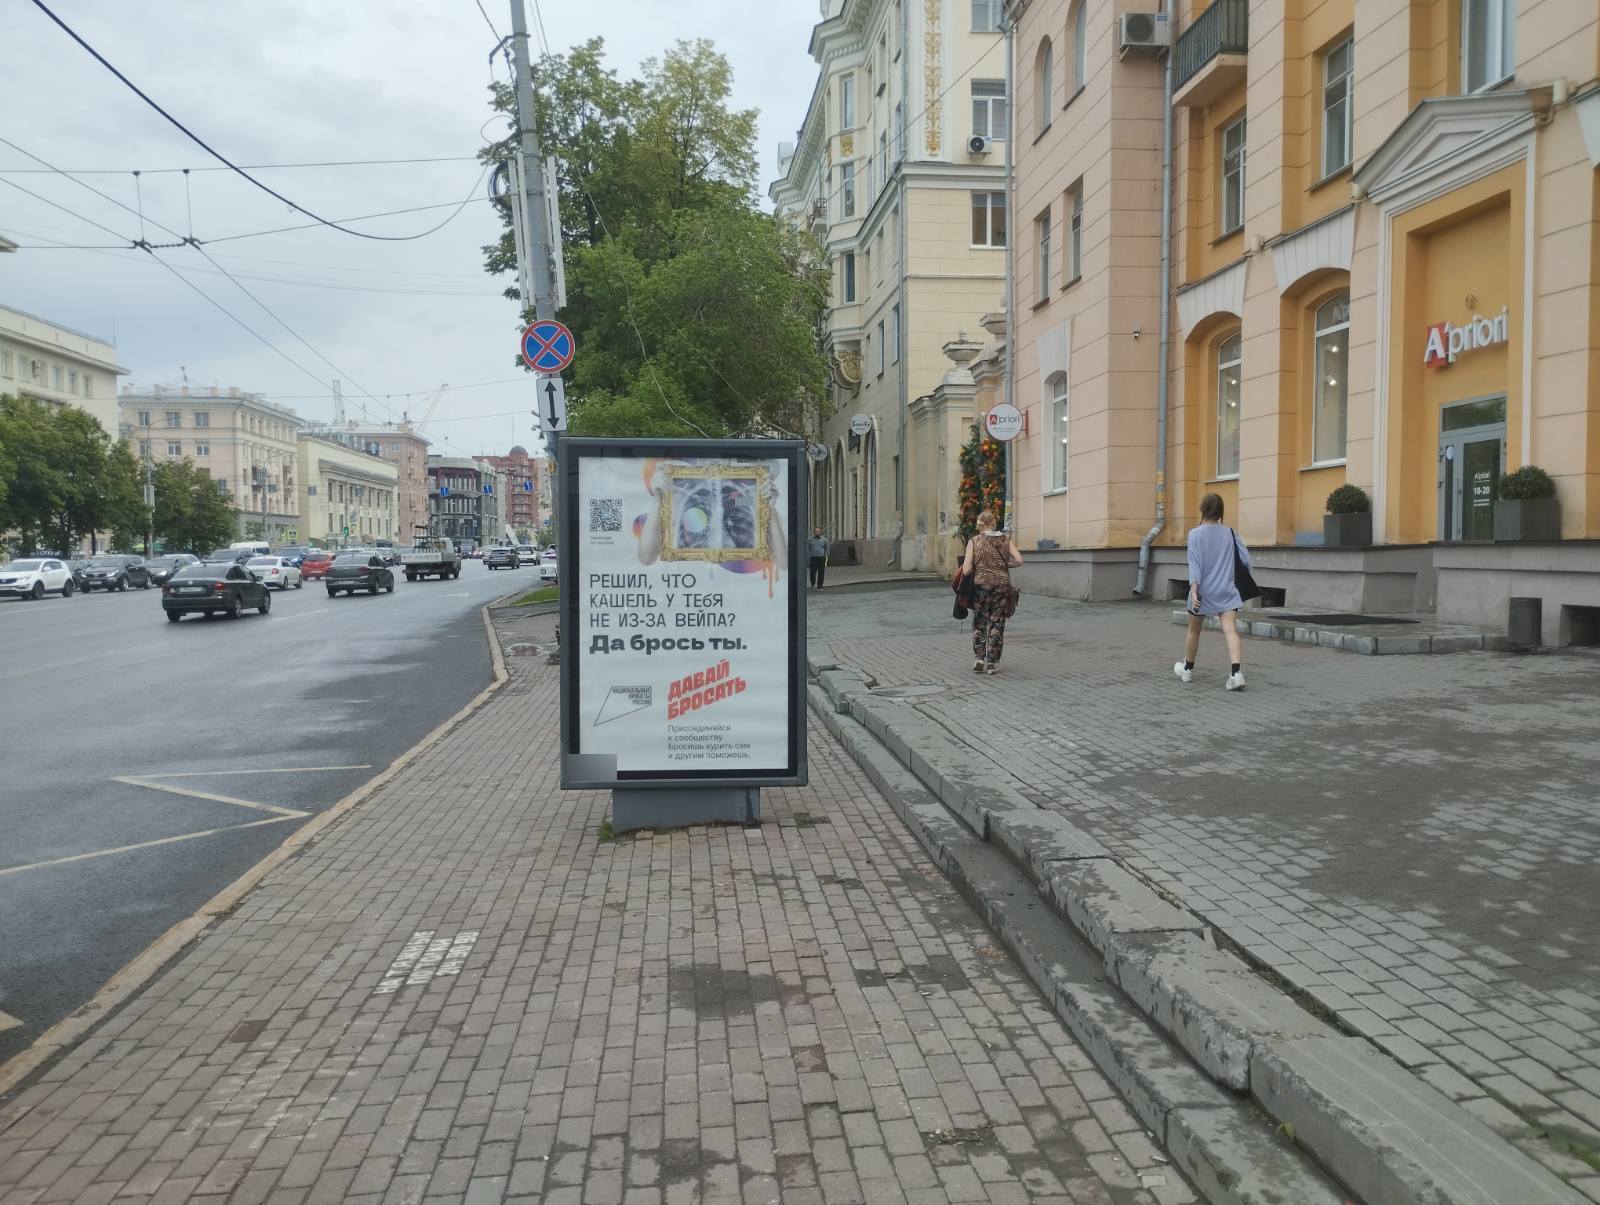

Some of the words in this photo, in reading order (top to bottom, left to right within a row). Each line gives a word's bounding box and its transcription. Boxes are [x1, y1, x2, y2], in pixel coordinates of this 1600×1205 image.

[1473, 486, 1490, 495] 10-20
[590, 574, 653, 590] РЕШИЛ,
[662, 574, 696, 588] ЧТО
[590, 593, 657, 608] КАШЕЛЬ
[665, 593, 675, 608] У
[590, 613, 610, 628] НЕ
[618, 613, 666, 628] ИЗ-ЗА
[675, 610, 736, 627] ВЕЙПА?
[589, 635, 625, 655] Да
[630, 634, 705, 655] брось
[708, 637, 747, 650] ты.
[668, 658, 730, 703] ДАВАЙ
[667, 677, 747, 721] БРОСАТЬ
[668, 724, 731, 733] Присоединяйся
[668, 743, 704, 752] Бросишь
[706, 743, 733, 752] курить
[675, 753, 704, 761] другим
